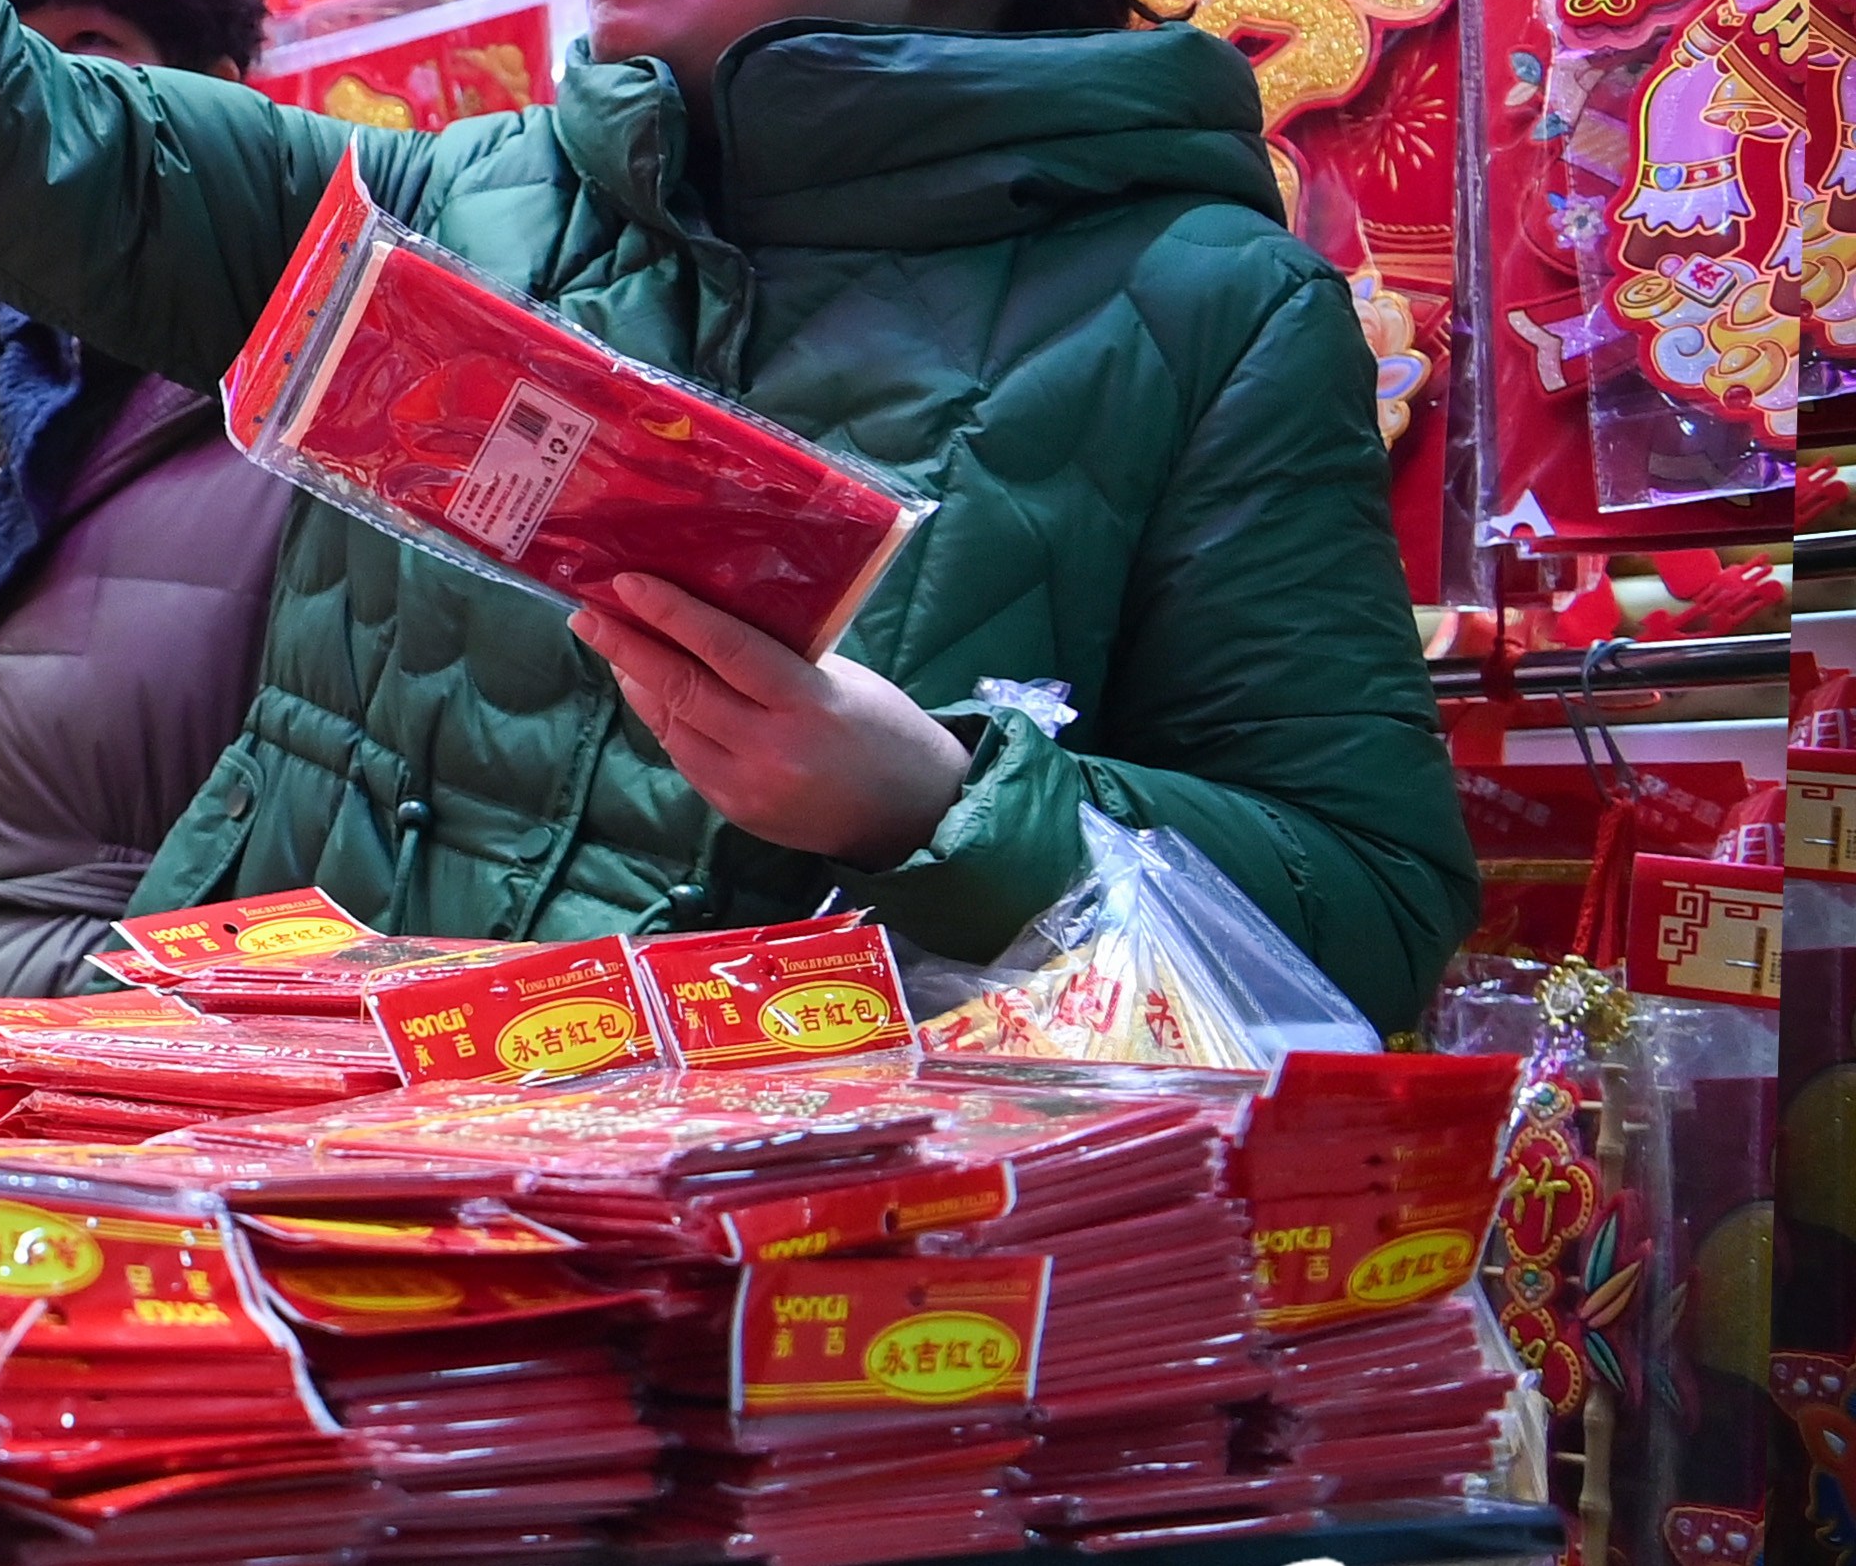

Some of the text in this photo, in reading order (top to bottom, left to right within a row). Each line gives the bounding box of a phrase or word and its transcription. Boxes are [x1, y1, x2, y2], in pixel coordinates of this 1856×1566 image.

[778, 956, 808, 973] YONG
[815, 956, 843, 968] PAPER
[514, 978, 545, 995] YONG
[555, 970, 581, 984] PAPER
[684, 1001, 741, 1030] 永吉
[414, 1033, 477, 1068] 永吉
